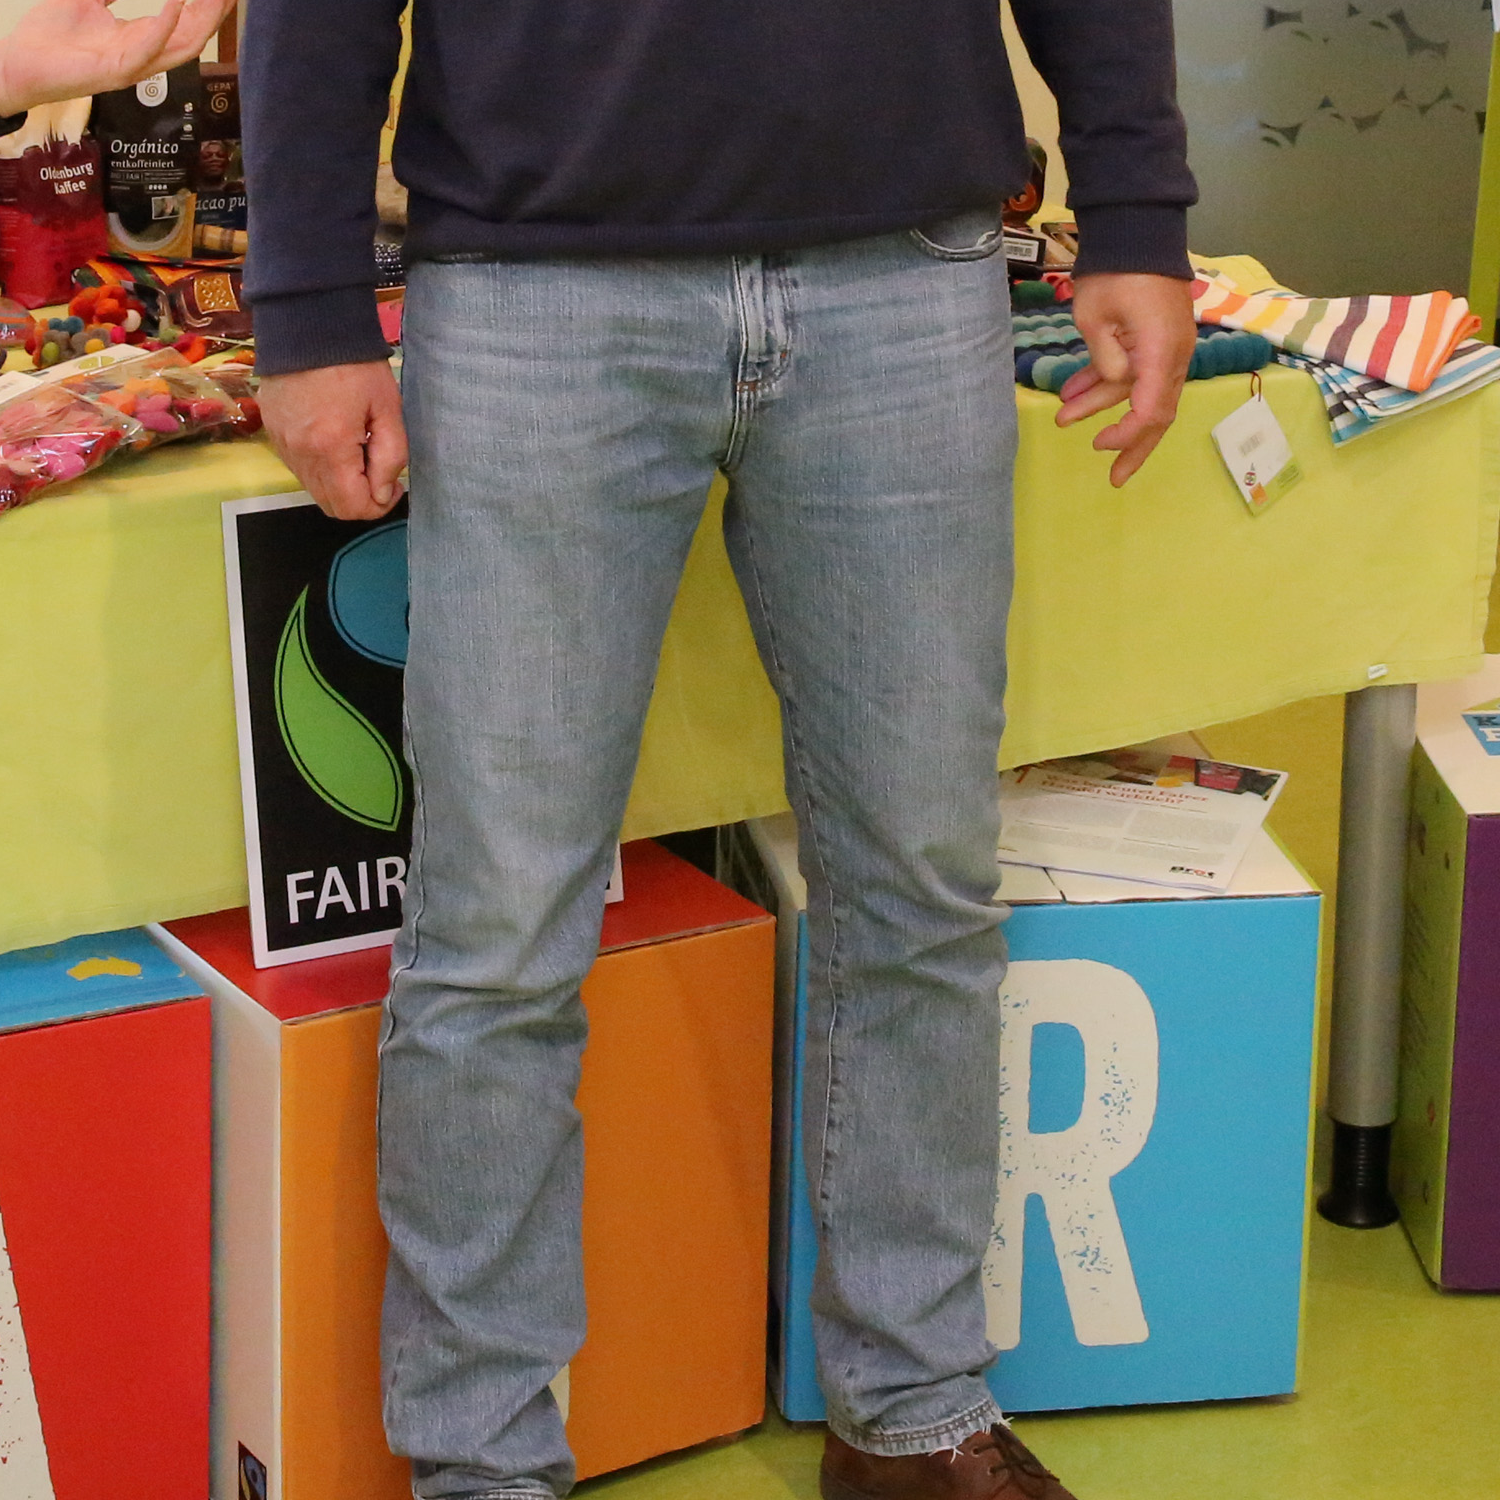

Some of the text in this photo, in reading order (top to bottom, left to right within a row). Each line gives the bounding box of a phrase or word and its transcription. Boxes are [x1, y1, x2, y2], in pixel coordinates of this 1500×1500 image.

[110, 138, 179, 159] Orgánico
[40, 162, 94, 181] Oldenburg
[110, 159, 175, 169] entkoffeiniert
[54, 180, 87, 195] Kaffee
[227, 194, 247, 213] pu
[286, 856, 409, 924] FAIR
[984, 959, 1159, 1351] R
